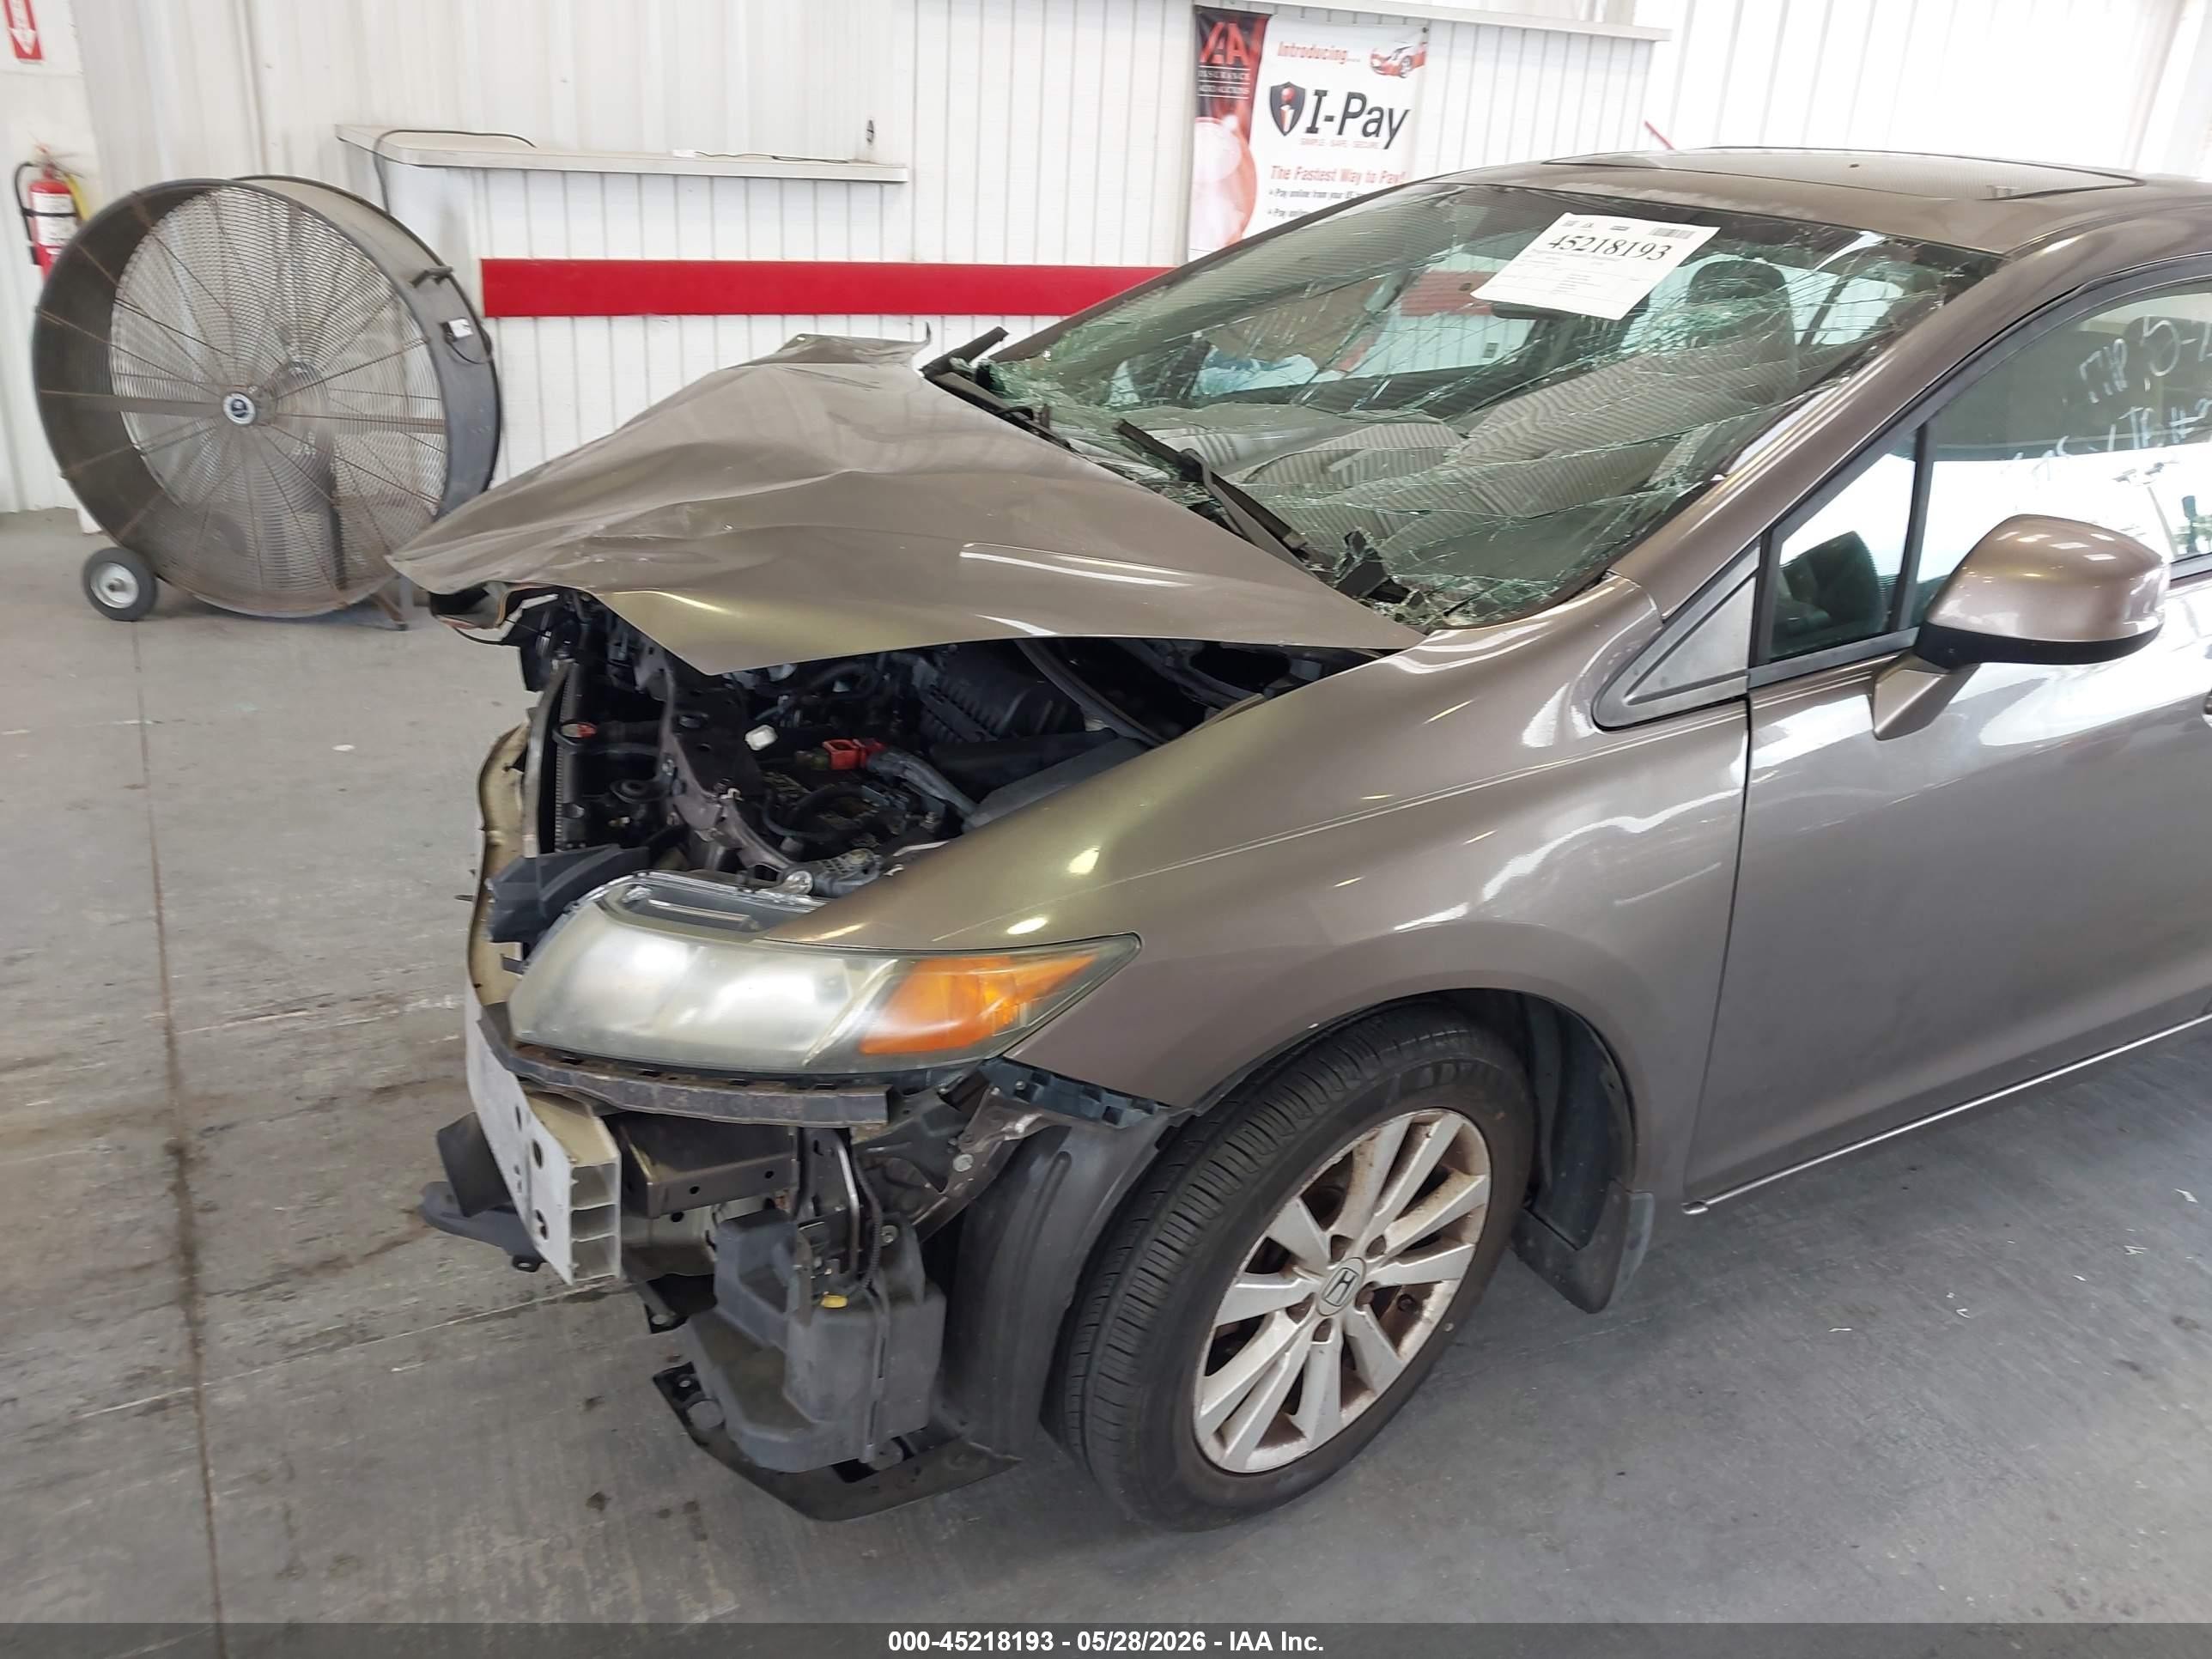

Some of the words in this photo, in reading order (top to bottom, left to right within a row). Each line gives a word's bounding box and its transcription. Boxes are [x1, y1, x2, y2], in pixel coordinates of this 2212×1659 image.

[1305, 89, 1411, 150] I-Pay
[1271, 166, 1291, 179] The
[1294, 167, 1336, 181] Fastest
[1365, 171, 1376, 183] to
[1548, 234, 1672, 261] 45218193
